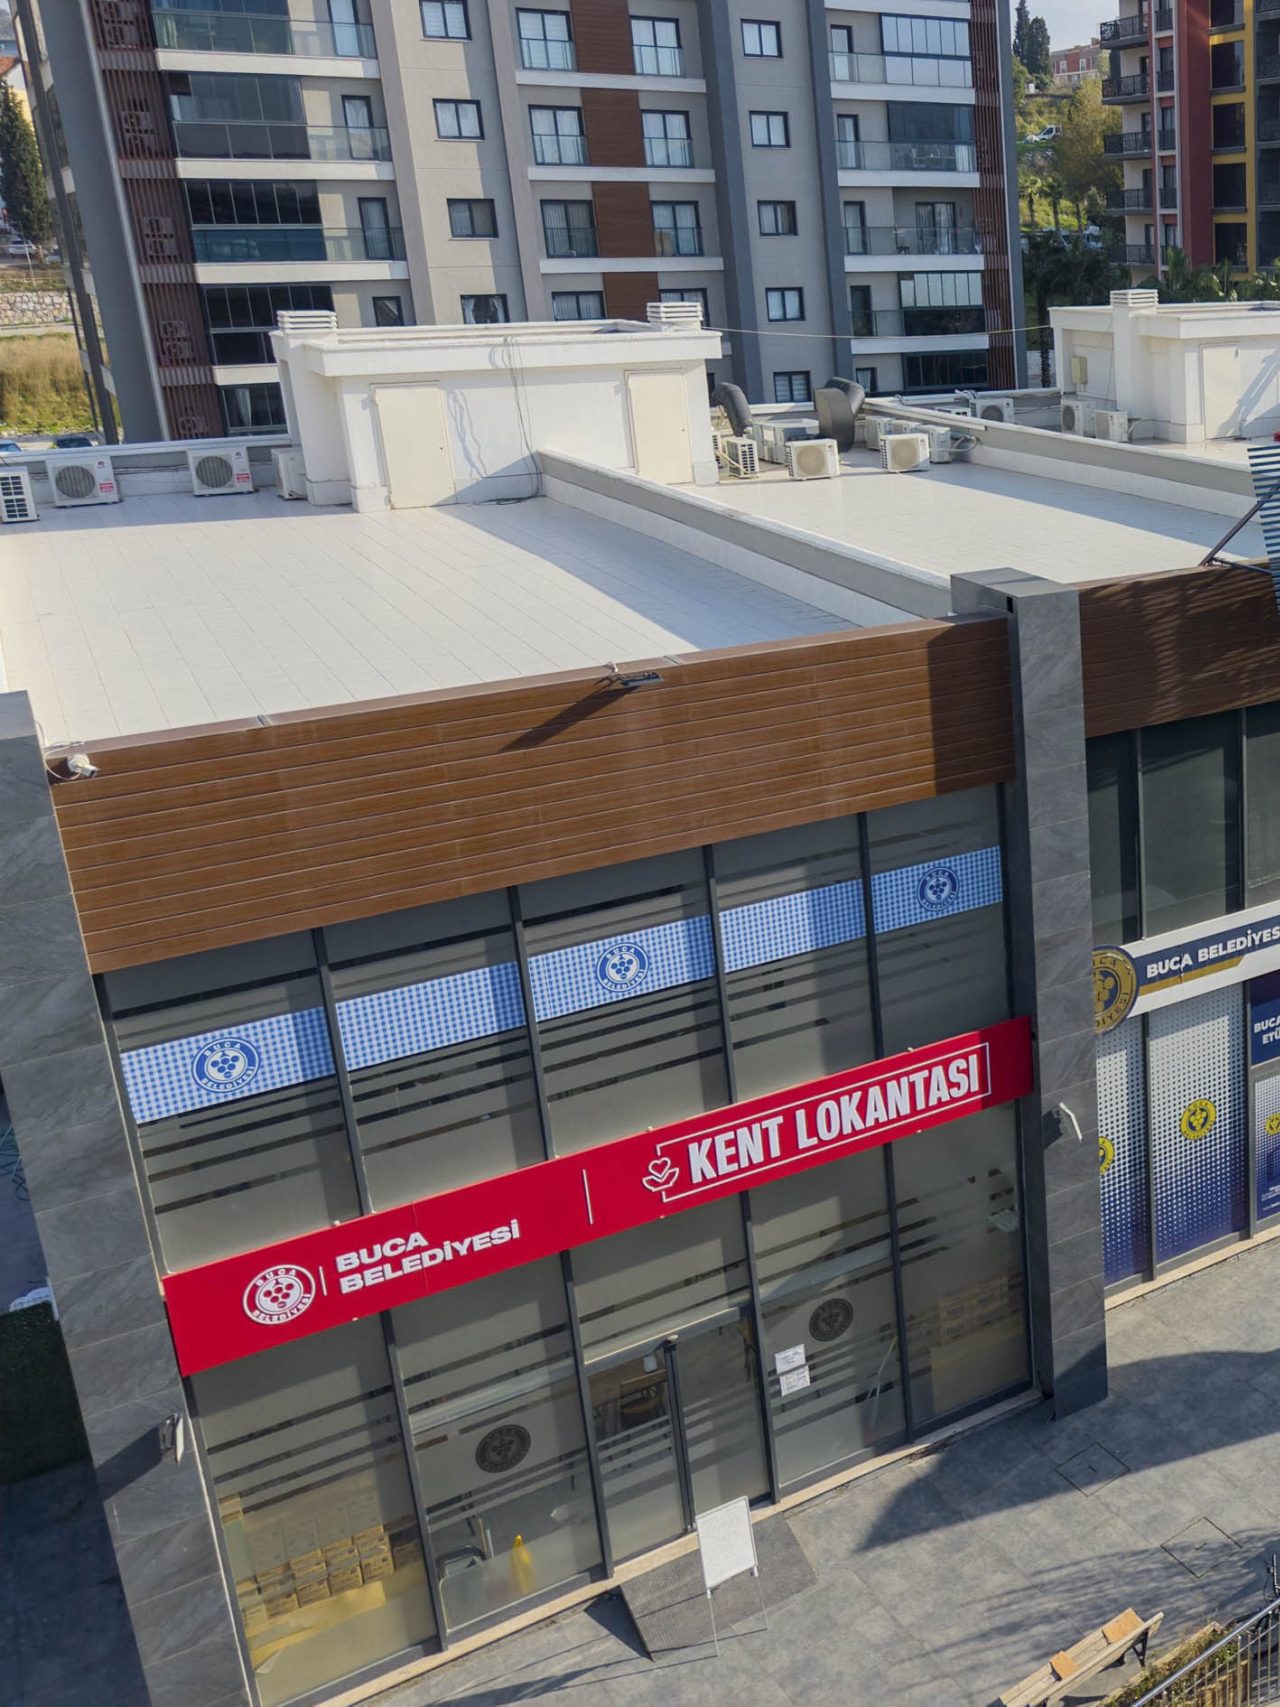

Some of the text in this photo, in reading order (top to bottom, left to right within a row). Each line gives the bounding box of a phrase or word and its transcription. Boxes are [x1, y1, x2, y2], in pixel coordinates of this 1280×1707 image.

[1147, 954, 1193, 978] BUCA
[687, 1054, 980, 1184] KENT LOKANTASI
[335, 1231, 428, 1273] BUCA
[338, 1219, 521, 1295] BELEDİYESİ
[255, 1268, 297, 1288] BUCA
